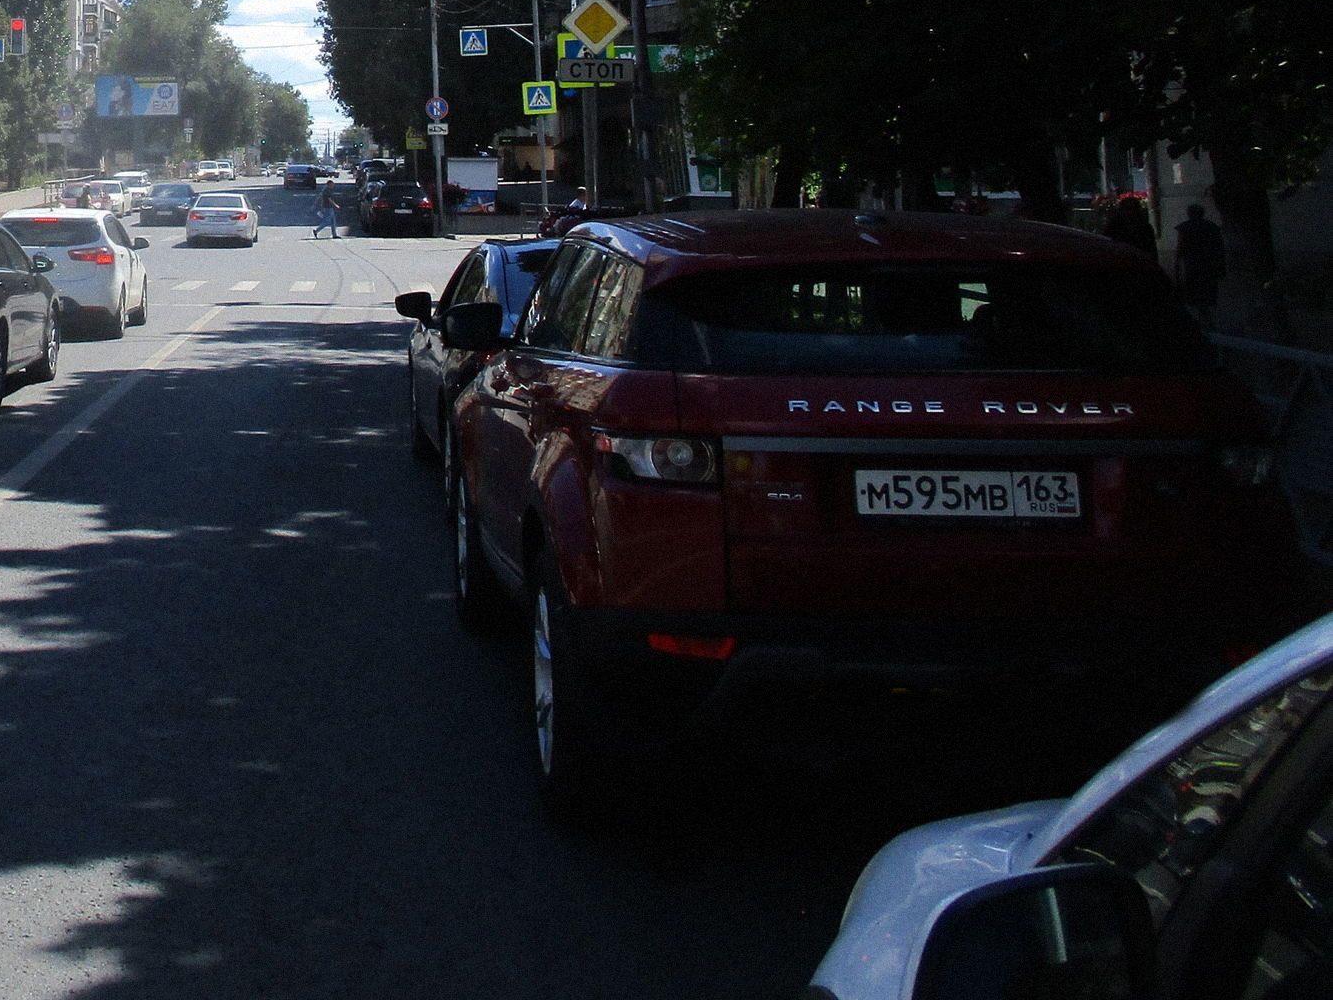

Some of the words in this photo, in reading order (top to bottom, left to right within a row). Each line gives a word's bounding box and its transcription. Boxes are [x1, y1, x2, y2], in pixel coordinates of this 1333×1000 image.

[570, 63, 624, 79] СТОП
[787, 400, 945, 413] RANGE
[982, 401, 1134, 415] ROVER
[866, 474, 1008, 510] М595МВ
[1016, 474, 1068, 500] 163
[1030, 502, 1056, 513] RUS
